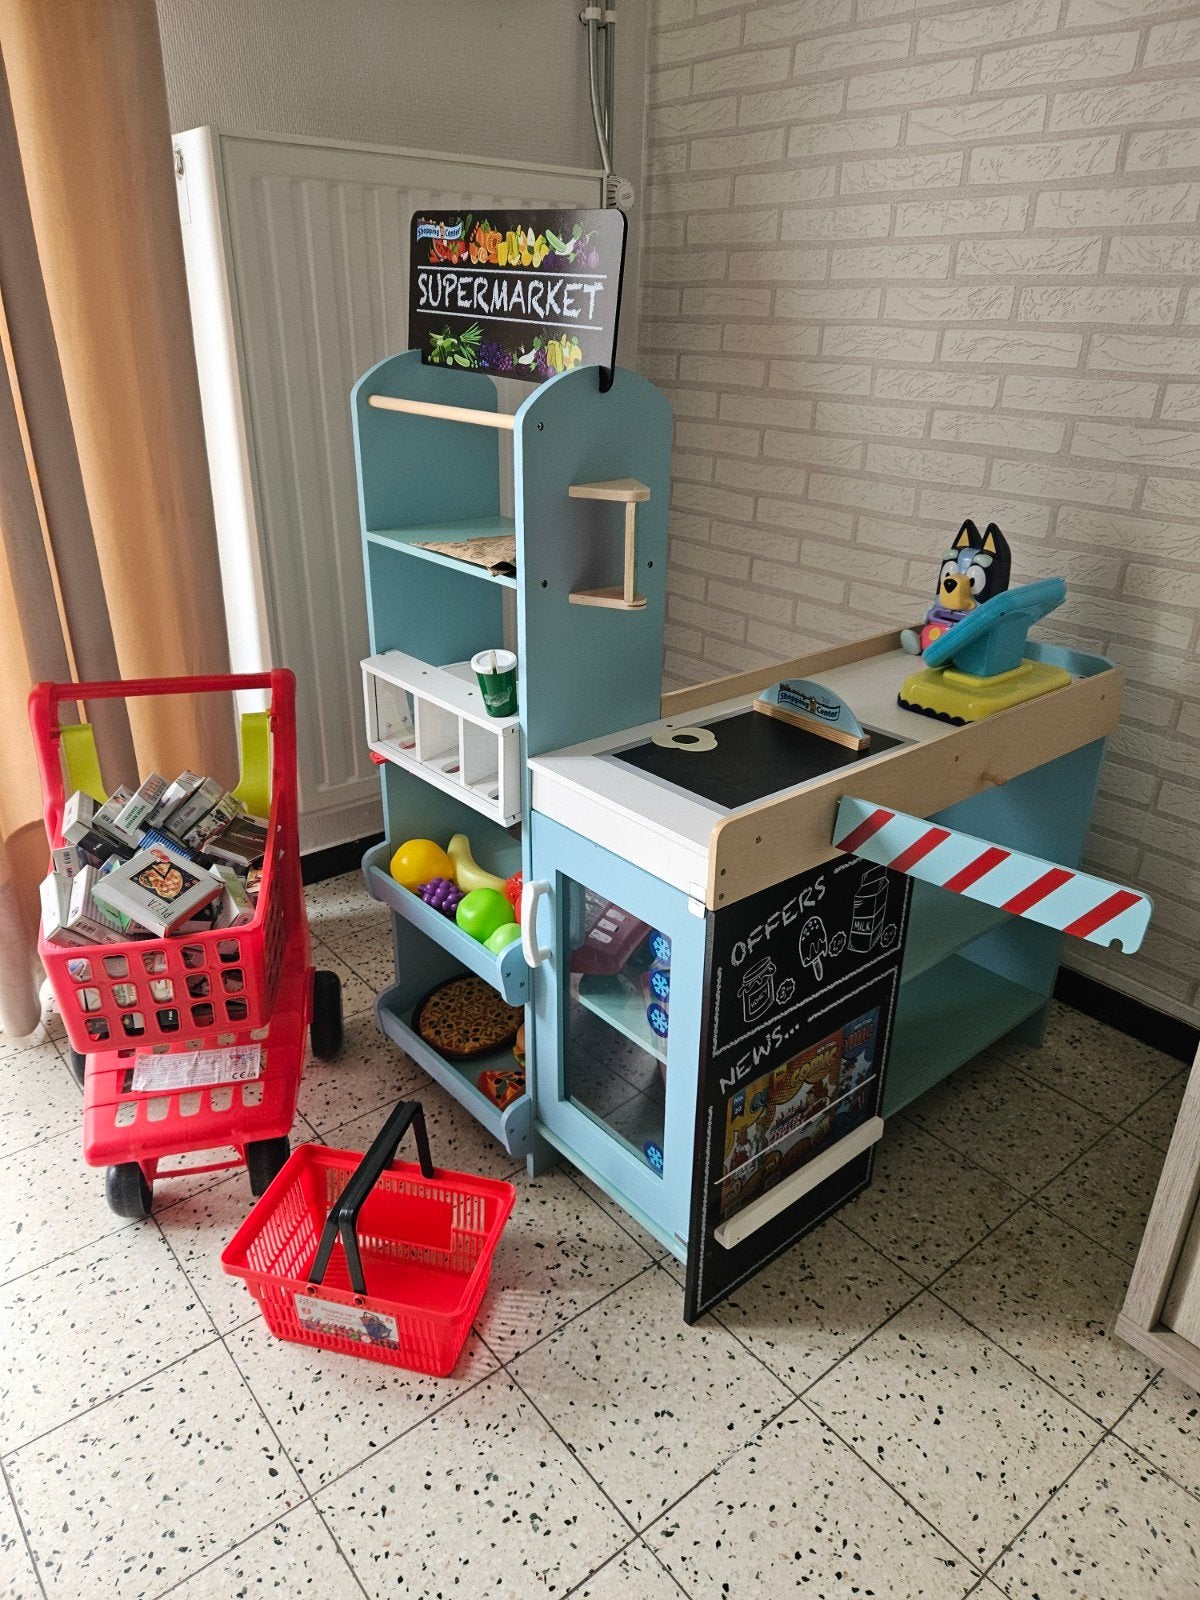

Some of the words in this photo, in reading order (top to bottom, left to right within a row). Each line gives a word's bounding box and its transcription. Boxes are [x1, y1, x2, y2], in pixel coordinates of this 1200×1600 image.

[418, 272, 604, 320] SUPERMARKET
[780, 692, 809, 708] Shopping
[816, 705, 838, 718] Center
[147, 898, 174, 919] PIZZA
[731, 875, 826, 966] OFFERS
[854, 920, 871, 932] MILK
[720, 1023, 800, 1095] NEWS...
